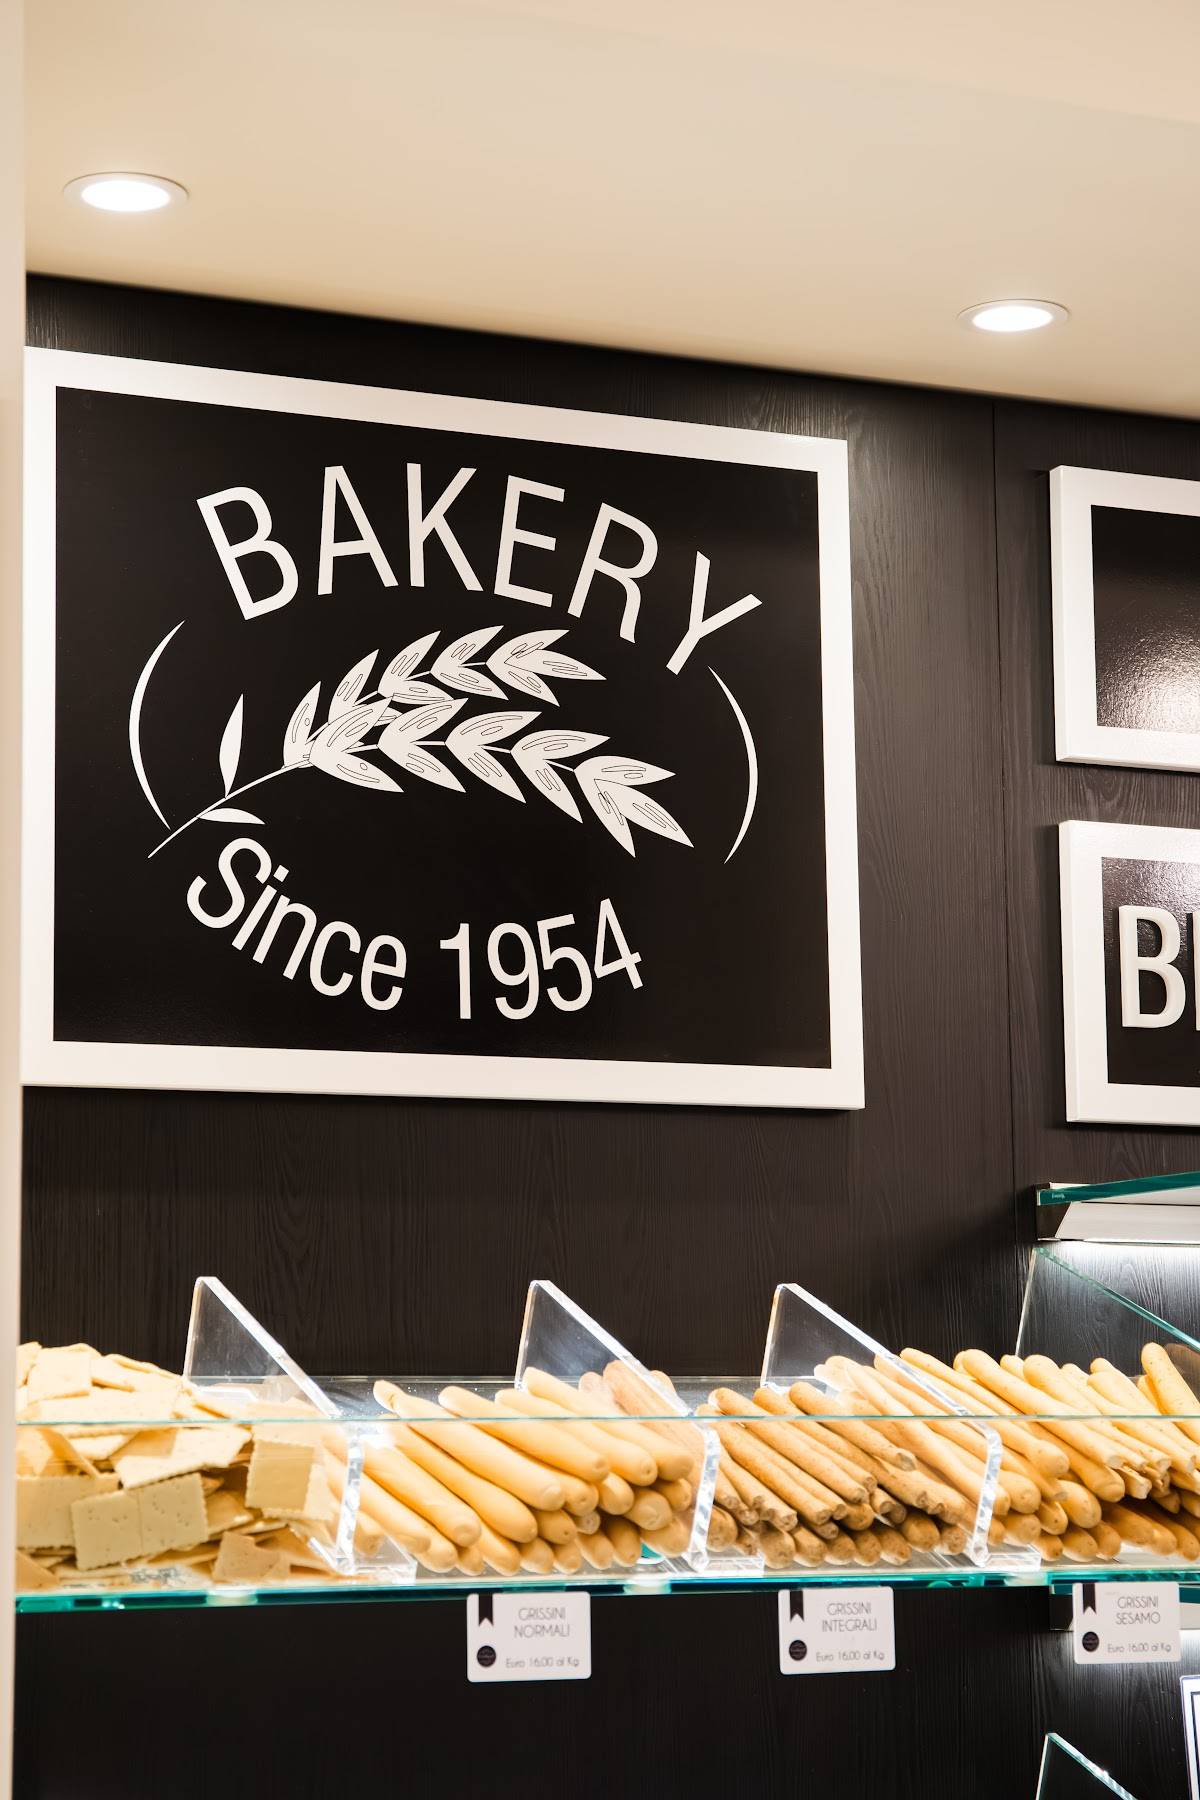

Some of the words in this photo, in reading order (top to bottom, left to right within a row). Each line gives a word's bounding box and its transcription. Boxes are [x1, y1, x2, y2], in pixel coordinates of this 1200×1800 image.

[196, 461, 763, 676] BAKERY
[186, 837, 408, 1012] Since
[439, 898, 643, 1020] 1954
[1118, 904, 1200, 1032] B
[826, 1601, 872, 1616] GRISSINI
[1117, 1596, 1159, 1609] GRISSINI
[518, 1606, 567, 1621] GRISSINI
[1115, 1611, 1161, 1625] SESAMO
[513, 1623, 571, 1639] NORMALI
[821, 1618, 878, 1633] INTEGRALI
[1107, 1643, 1125, 1653] Euro
[505, 1657, 526, 1669] Euro
[815, 1651, 834, 1662] Euro
